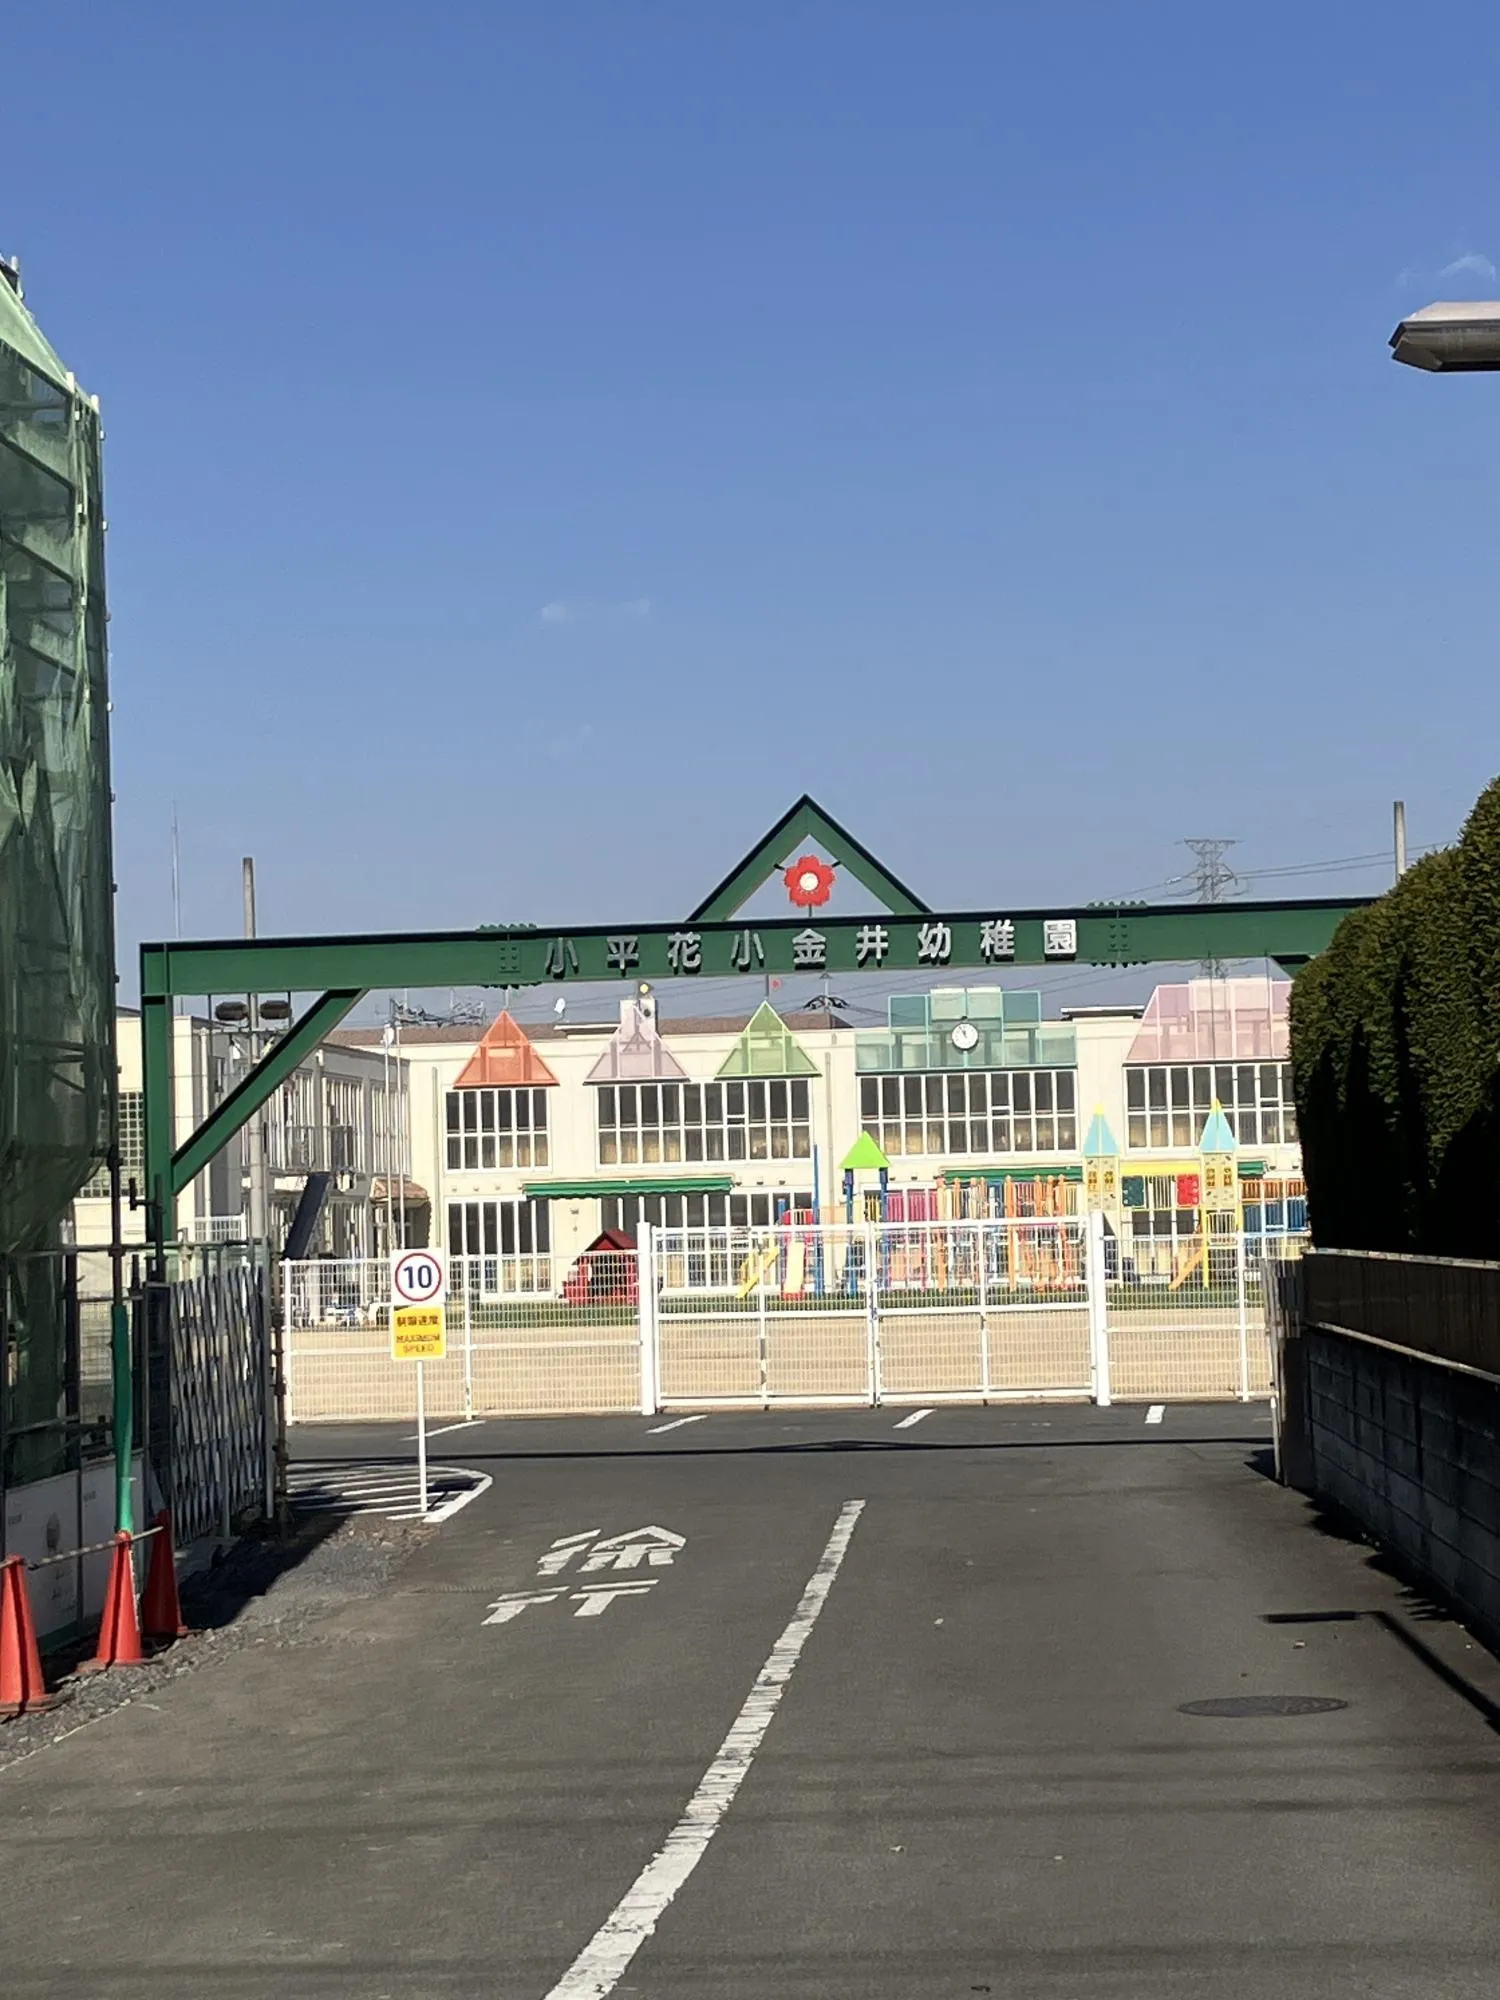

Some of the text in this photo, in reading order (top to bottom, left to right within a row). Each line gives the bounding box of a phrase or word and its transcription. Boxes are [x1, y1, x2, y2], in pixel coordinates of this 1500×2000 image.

[546, 919, 1077, 974] 小平花小金井幼稚園
[403, 1265, 432, 1289] 10
